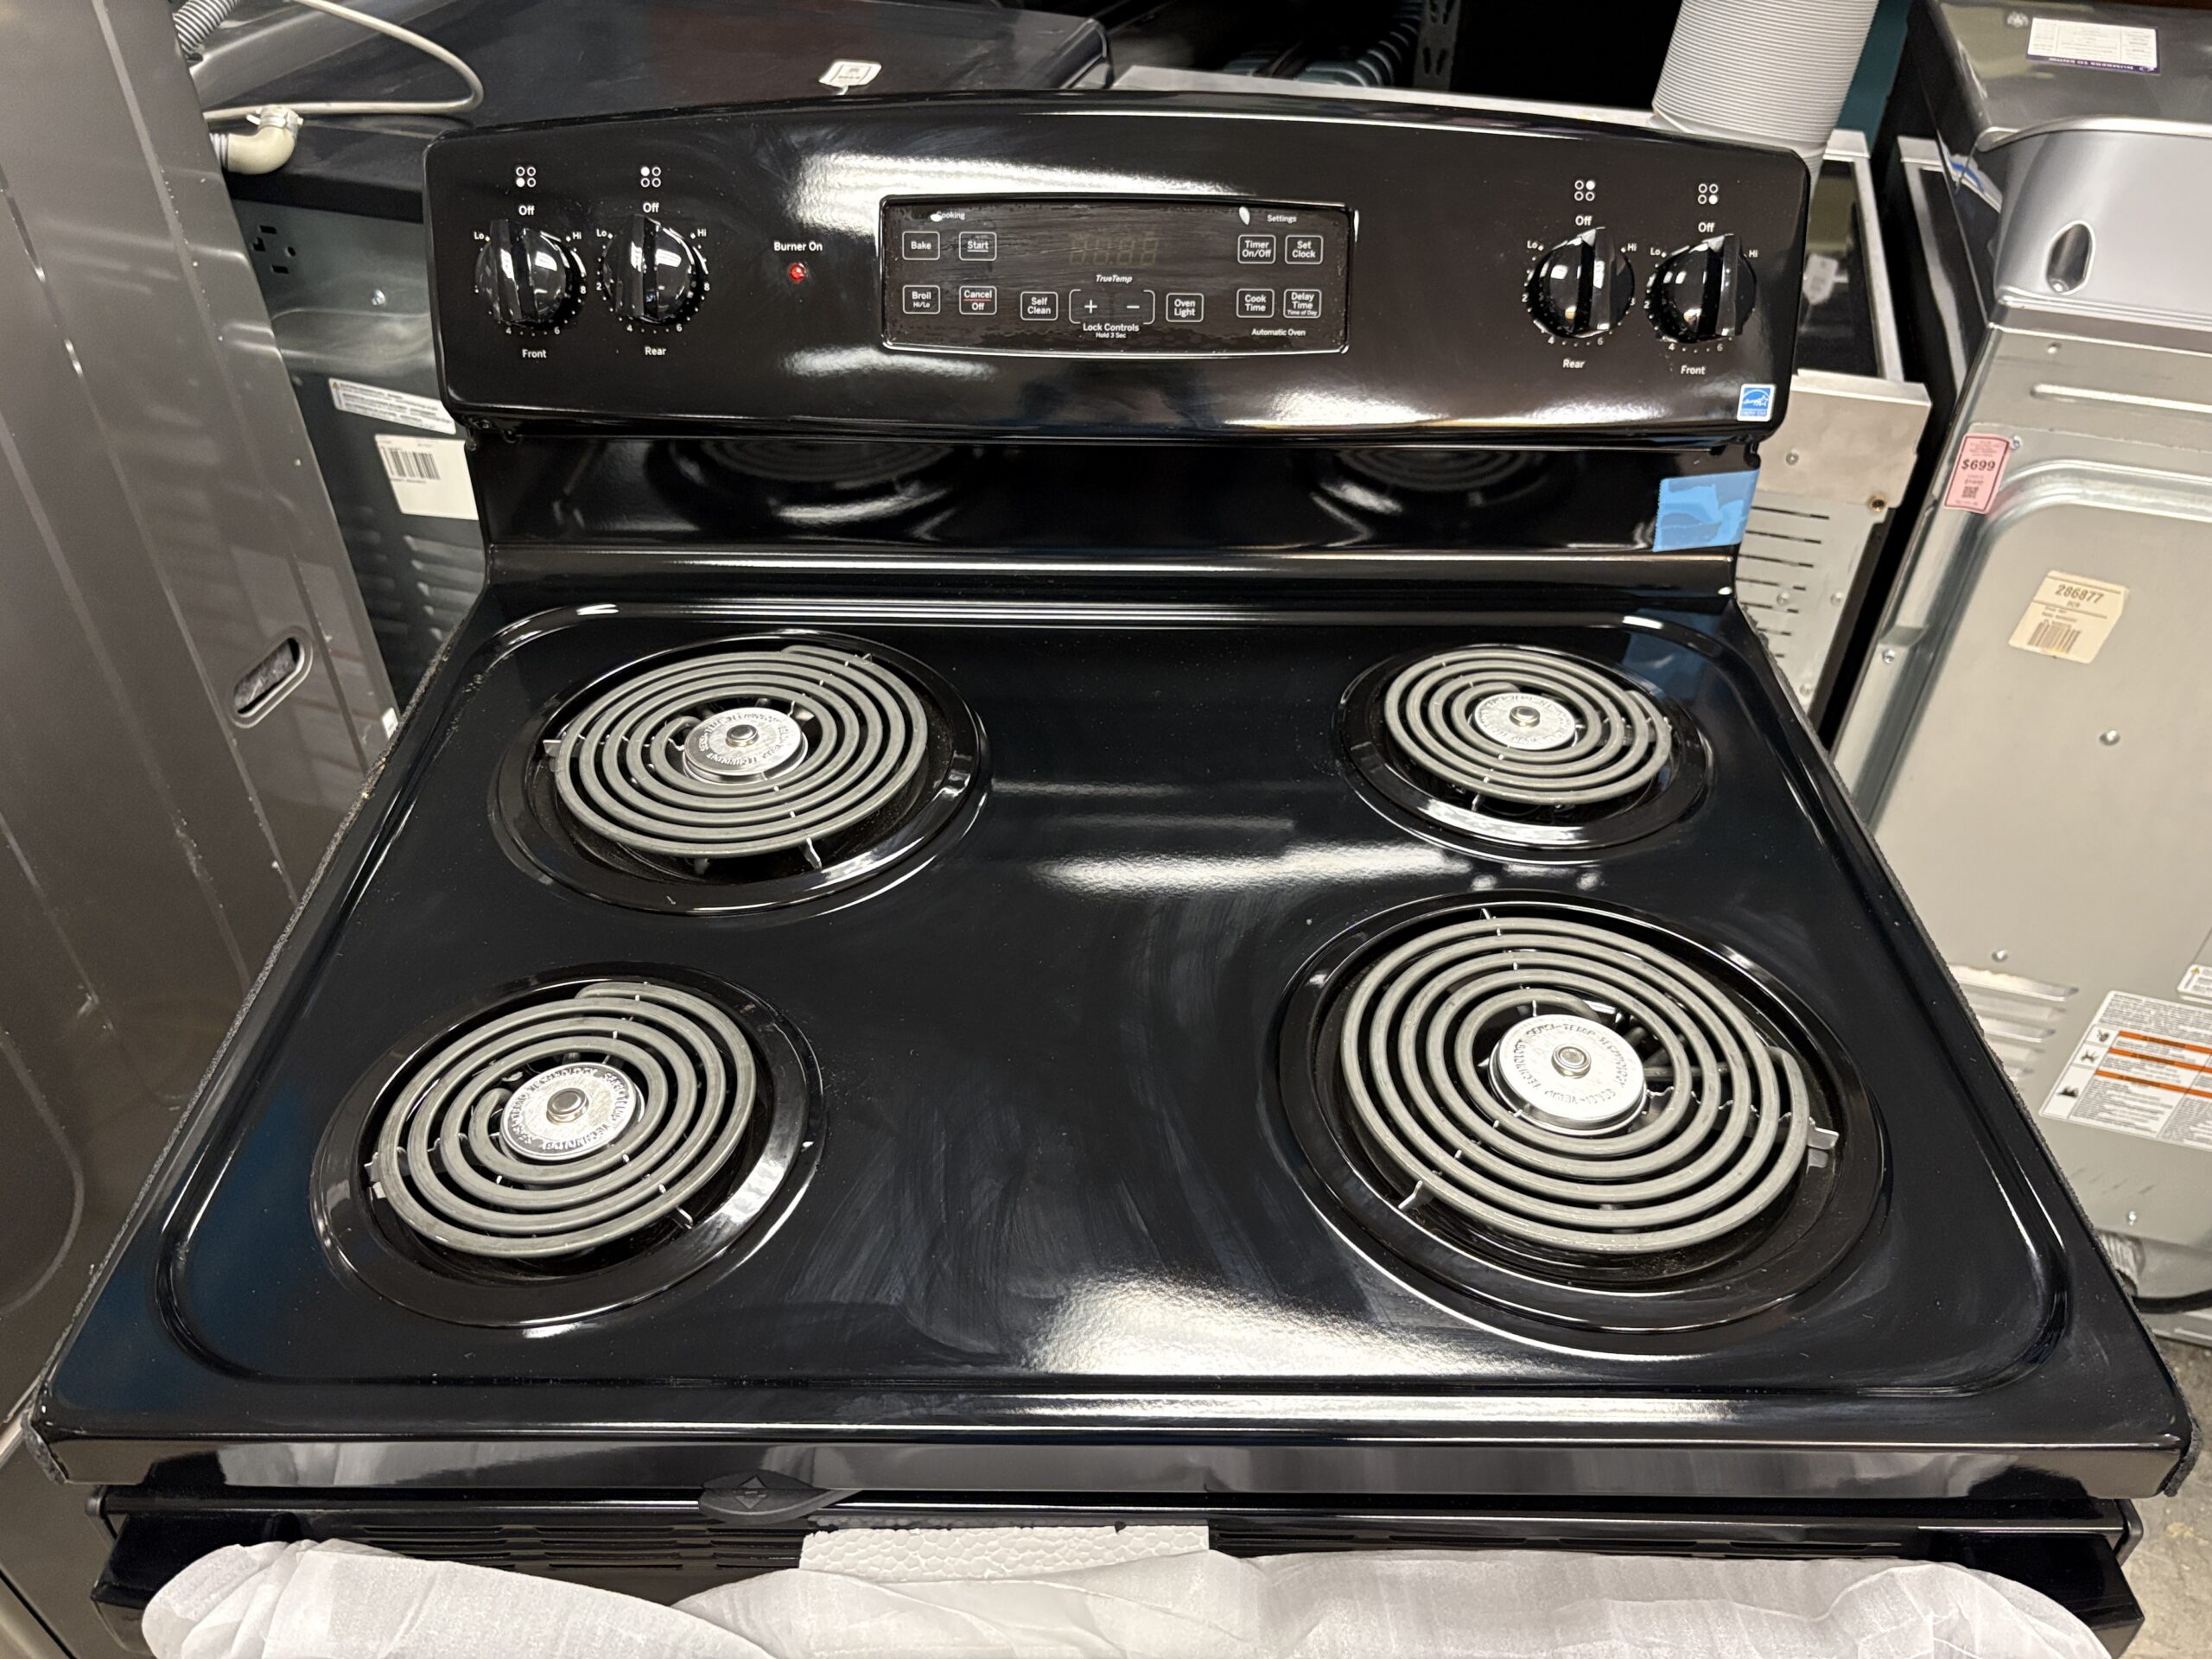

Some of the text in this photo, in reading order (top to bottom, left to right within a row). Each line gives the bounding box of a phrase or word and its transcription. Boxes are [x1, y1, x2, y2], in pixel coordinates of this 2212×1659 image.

[518, 205, 535, 216] Off
[643, 202, 659, 213] Off
[1267, 214, 1297, 223] Settings
[1575, 215, 1592, 226] Off
[1699, 222, 1715, 233] Off
[474, 232, 485, 240] Lo
[773, 241, 823, 251] Burner On
[911, 241, 931, 250] Bake
[967, 241, 988, 250] Start
[1297, 241, 1312, 250] Set
[1527, 240, 1538, 249] Lo
[1627, 243, 1637, 251] Hi
[1242, 250, 1272, 258] On/Off
[1292, 250, 1316, 258] Clock
[1650, 247, 1661, 256] Lo
[1096, 275, 1133, 283] TrueTemp
[580, 286, 587, 295] 8
[595, 283, 602, 291] 2
[703, 283, 710, 291] 8
[912, 291, 931, 300] Broil
[963, 290, 993, 299] Cancel
[1244, 295, 1267, 303] Cook
[1291, 292, 1314, 302] Delay
[1521, 293, 1529, 302] 2
[1031, 297, 1048, 306] Self
[1173, 299, 1196, 308] Oven
[1643, 300, 1650, 309] 2
[971, 302, 985, 311] Off
[1027, 306, 1052, 315] Clean
[1244, 303, 1266, 312] Time
[1173, 308, 1196, 317] Light
[1103, 323, 1139, 332] Controls
[1669, 342, 1675, 351] 4
[1717, 343, 1723, 352] 6
[522, 348, 547, 359] Front
[645, 346, 666, 357] Rear
[1562, 359, 1586, 369] Rear
[1681, 365, 1706, 375] Front
[1961, 457, 1996, 472] $699
[2055, 583, 2105, 604] 286877
